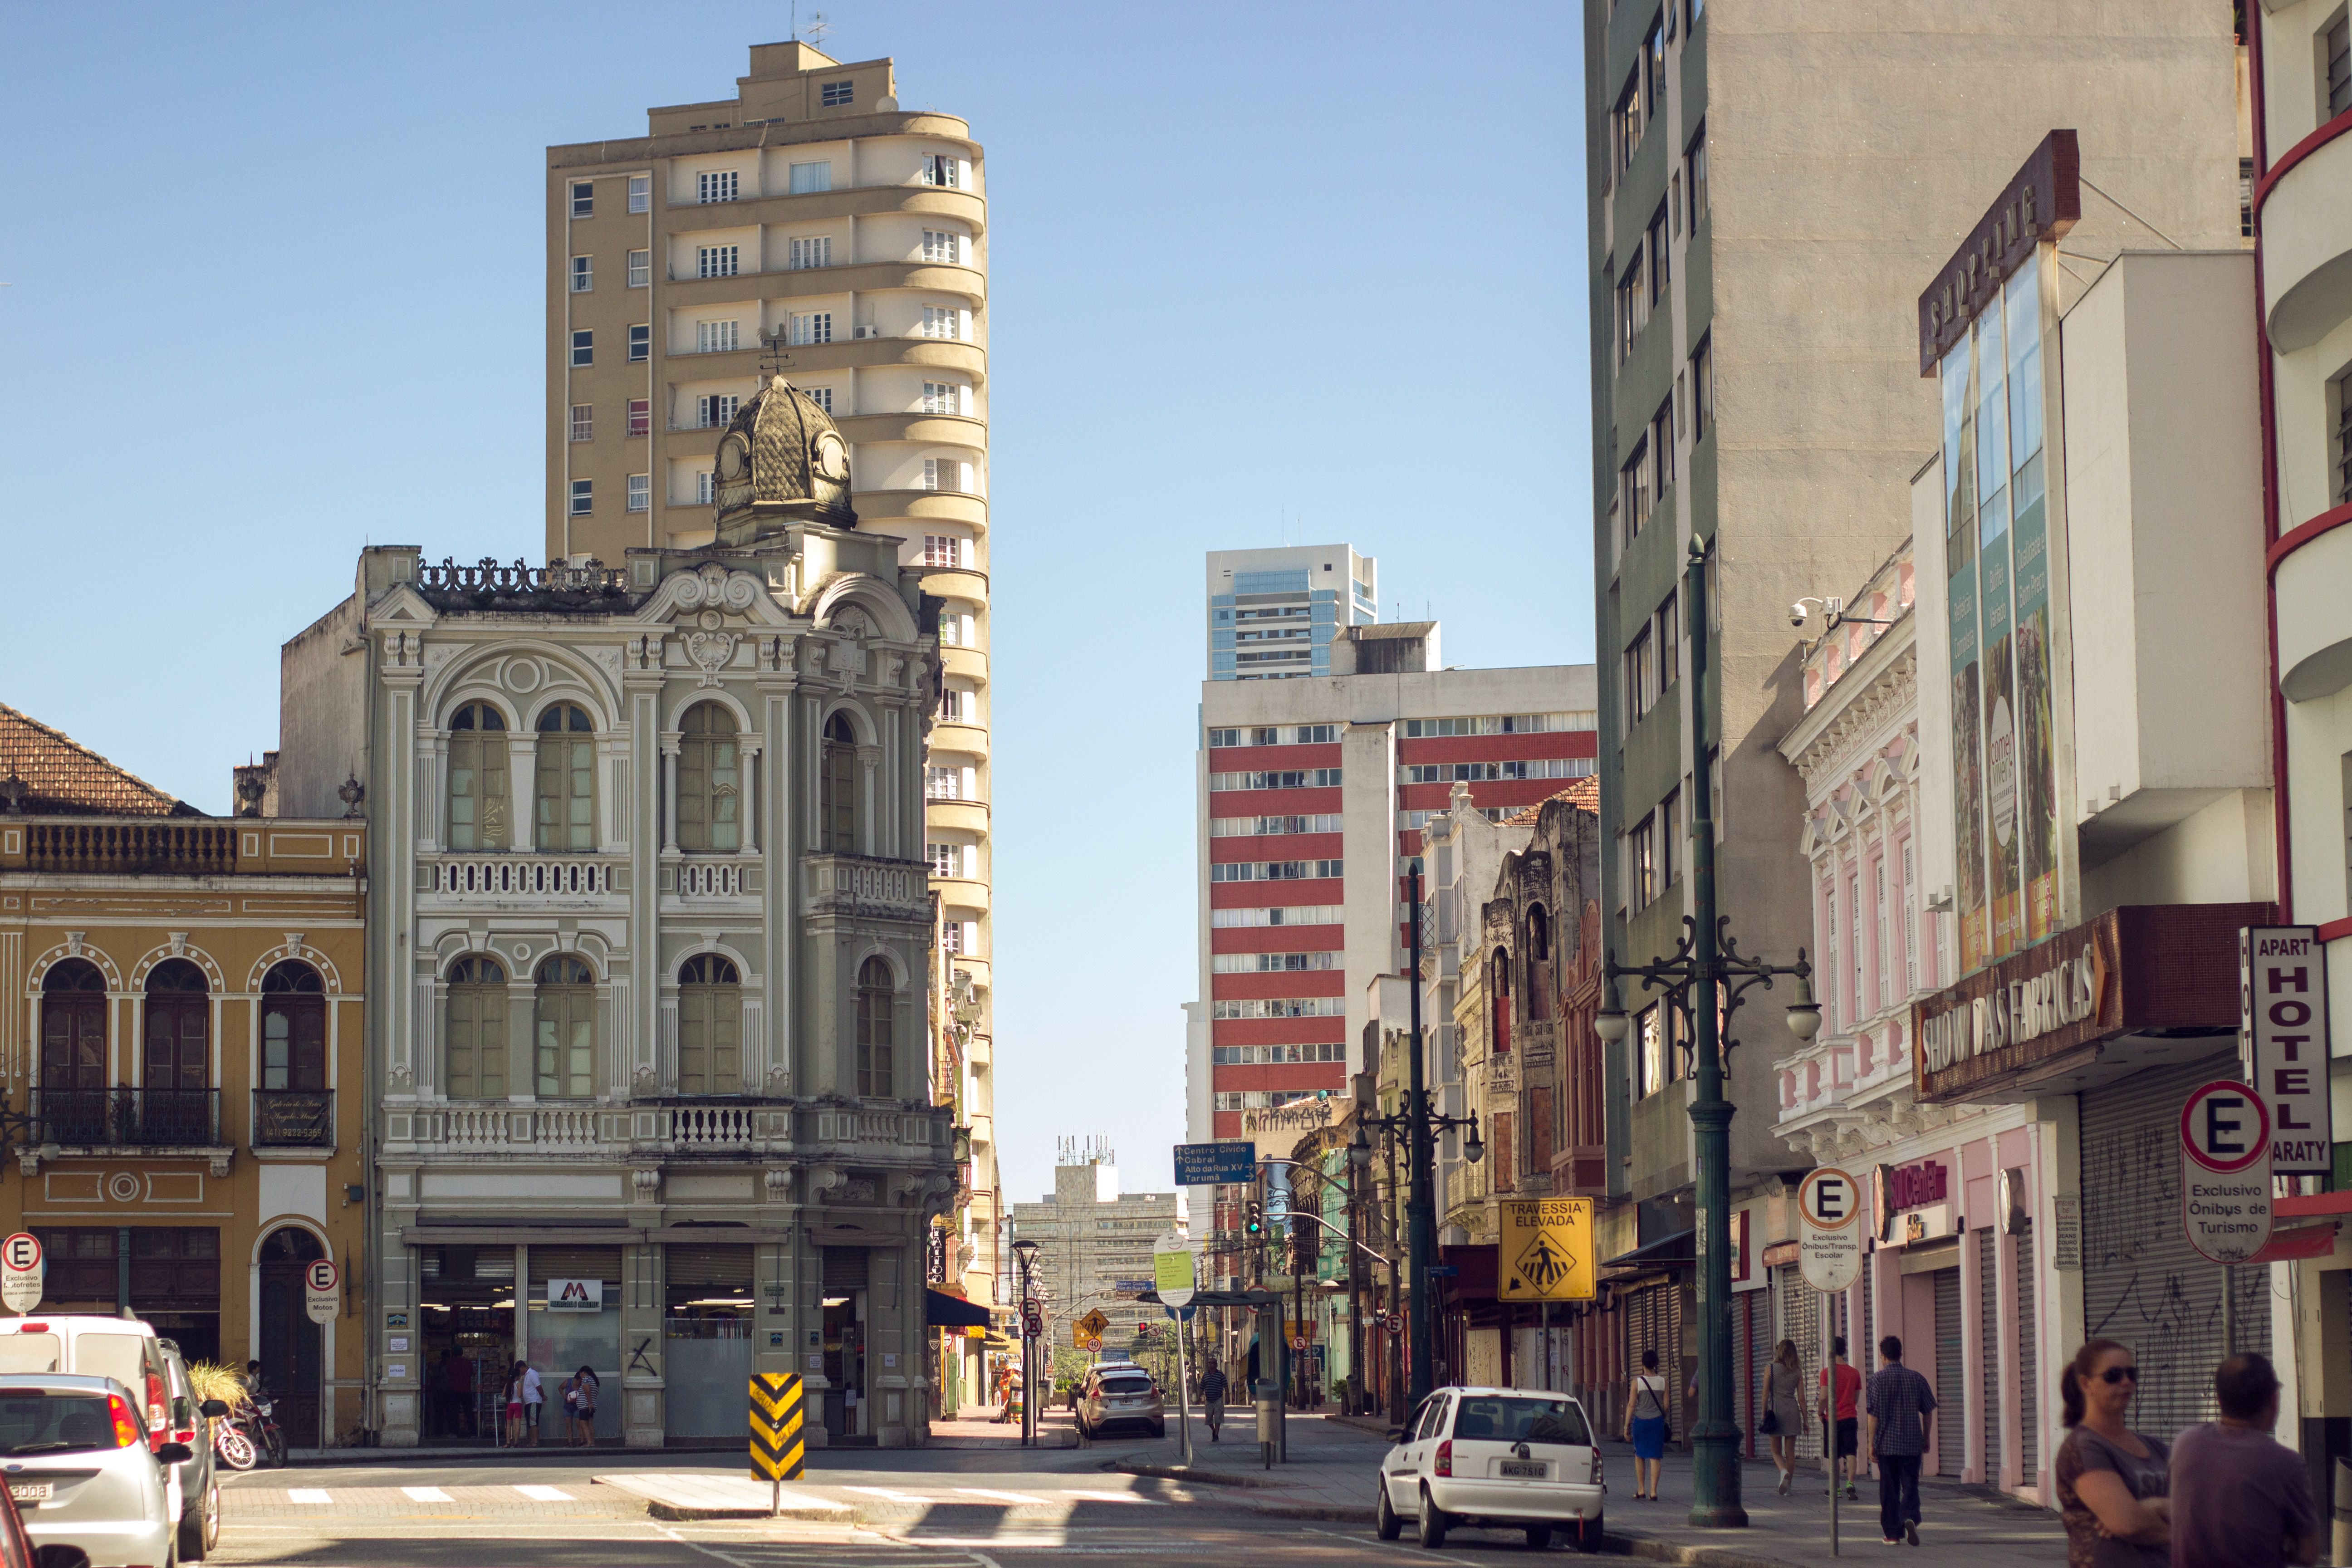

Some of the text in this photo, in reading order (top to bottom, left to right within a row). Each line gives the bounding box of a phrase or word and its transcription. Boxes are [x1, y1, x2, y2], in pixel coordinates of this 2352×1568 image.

[1931, 184, 2034, 337] SHOPPING
[2017, 533, 2041, 577] Qualidade
[1989, 562, 2004, 594] Buffet
[2019, 571, 2045, 609] Bom Preço
[1989, 596, 2006, 631] Variado
[1955, 627, 1974, 660] Completa
[1991, 730, 2012, 766] comer
[2034, 877, 2052, 902] comer
[2259, 938, 2310, 956] APART
[1923, 943, 2096, 1075] SHOW DAS FABRICAS
[2241, 935, 2252, 1085] HOT
[2268, 966, 2311, 1129] HOTEL
[2207, 1098, 2245, 1153] E
[1185, 1156, 1215, 1164] Cabral
[1219, 1145, 1246, 1153] Cívico
[1186, 1174, 1220, 1182] Tarumã
[1231, 1163, 1243, 1171] XV
[1818, 1180, 1843, 1217] E
[2192, 1184, 2262, 1197] Exclusivo
[1509, 1203, 1582, 1215] TRAVESSIA
[2190, 1200, 2267, 1215] Ônibus de
[1516, 1215, 1575, 1227] ELEVADA
[2198, 1221, 2258, 1233] Turismo
[14, 1241, 30, 1264] E
[931, 1227, 943, 1284] TATTOO
[1802, 1242, 1858, 1251] Ônibus/Transp.
[315, 1265, 329, 1285] E
[560, 1282, 589, 1301] M
[1391, 1317, 1399, 1330] E
